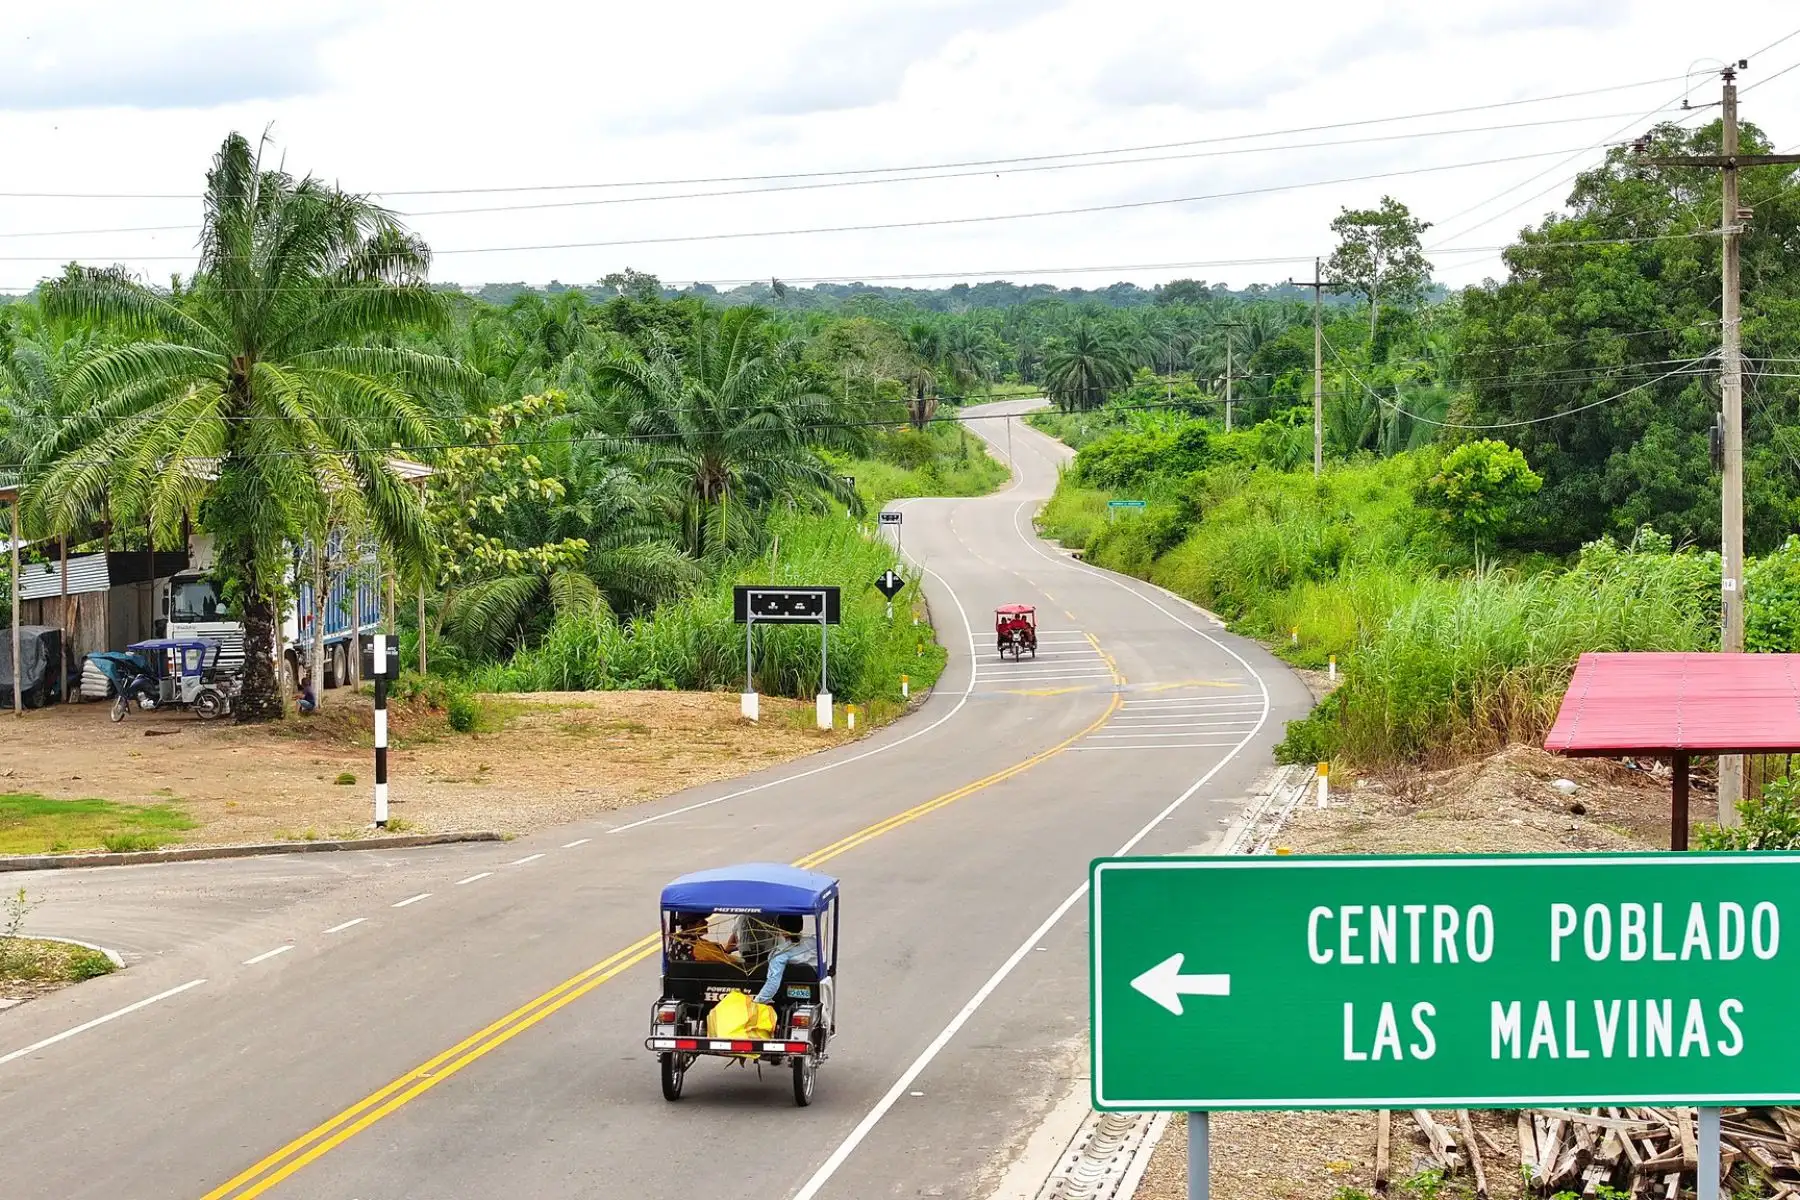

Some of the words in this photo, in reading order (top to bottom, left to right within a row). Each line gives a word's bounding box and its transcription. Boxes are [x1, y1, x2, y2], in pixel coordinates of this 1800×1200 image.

[1307, 904, 1495, 965] CENTRO
[1551, 901, 1780, 962] POBLADO
[1343, 1001, 1437, 1061] LAS
[1491, 998, 1745, 1059] MALVINAS
